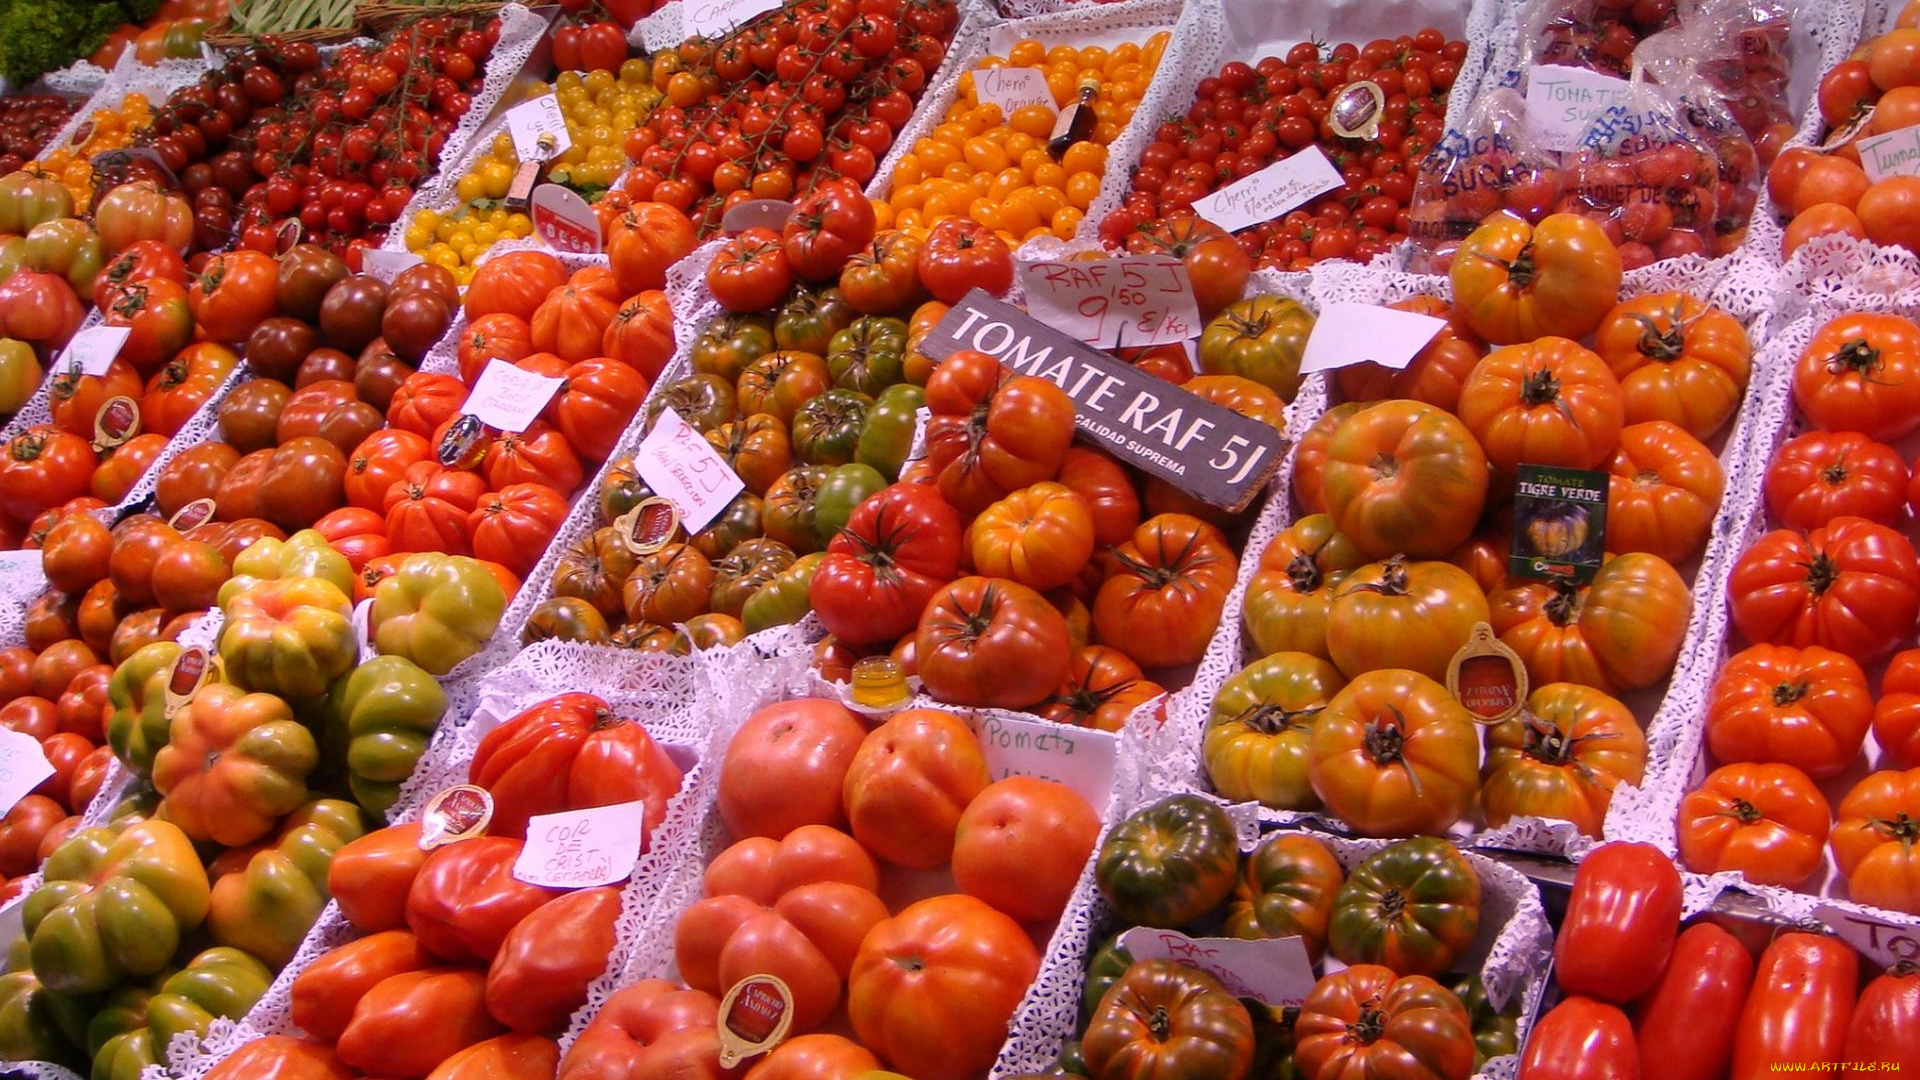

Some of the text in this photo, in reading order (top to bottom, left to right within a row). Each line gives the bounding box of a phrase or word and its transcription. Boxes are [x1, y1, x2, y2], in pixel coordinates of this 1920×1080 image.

[1029, 262, 1108, 292] RAF
[951, 306, 1268, 485] TOMATE RAF 5J
[1074, 413, 1187, 476] CALIDAD SUPREMA
[1519, 482, 1602, 502] TIGRE VERDE
